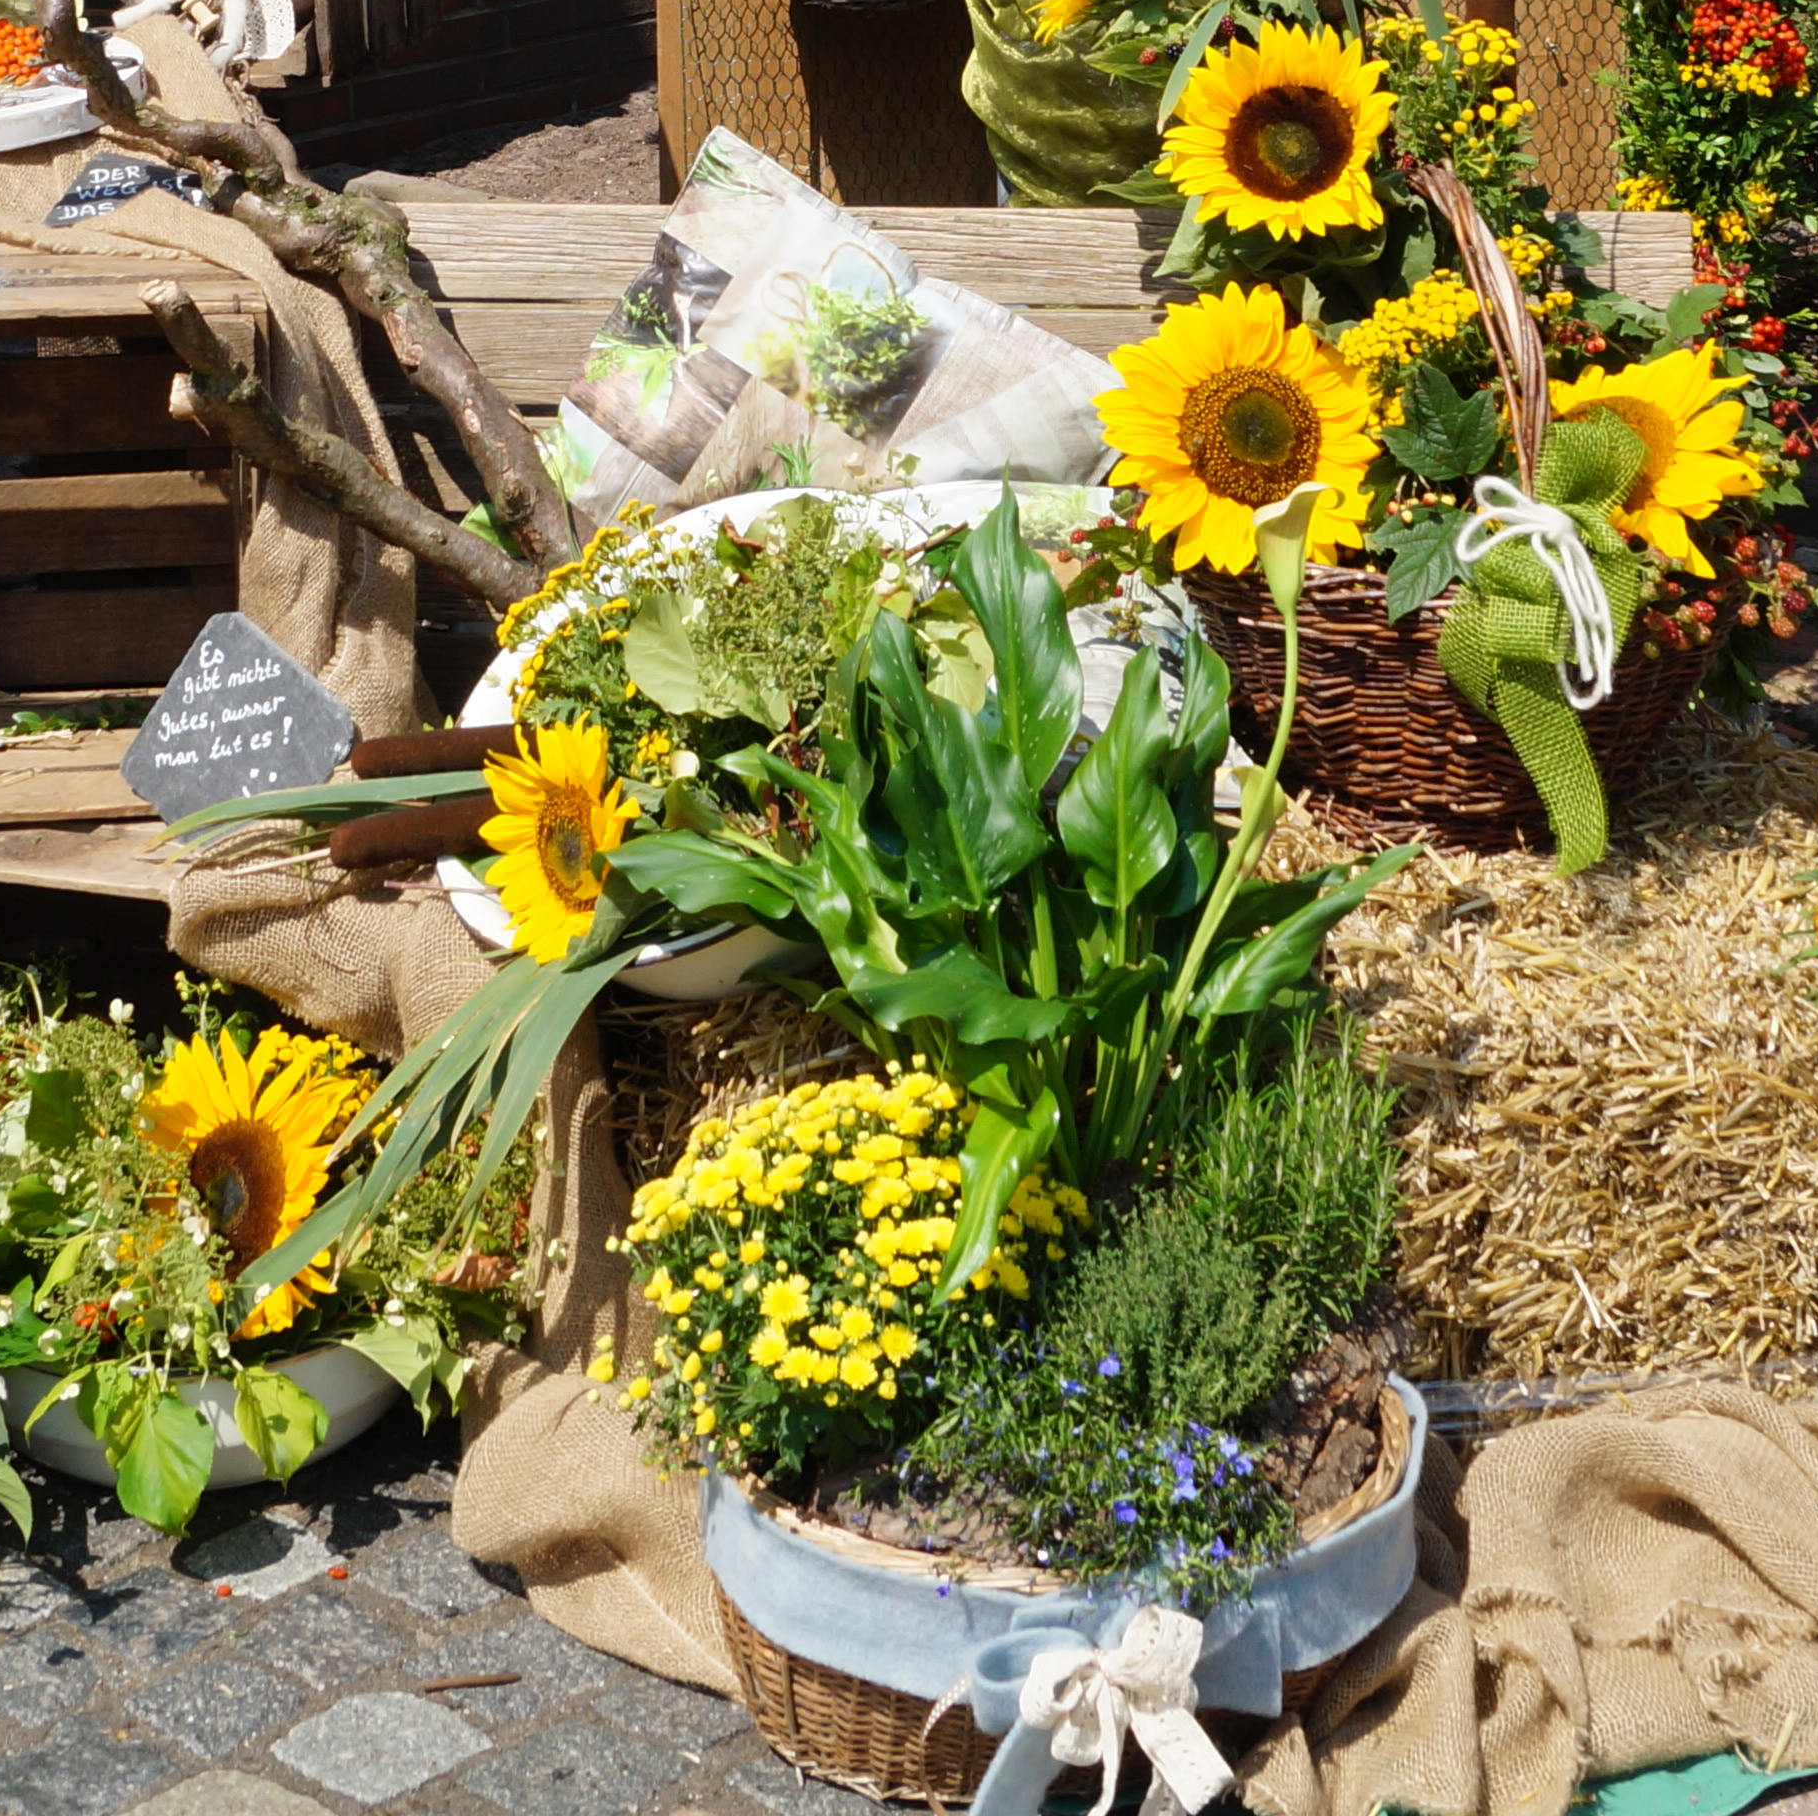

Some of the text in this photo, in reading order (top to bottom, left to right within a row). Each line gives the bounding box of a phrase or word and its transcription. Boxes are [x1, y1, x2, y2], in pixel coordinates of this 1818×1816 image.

[88, 165, 141, 184] DER
[75, 181, 139, 200] WEG
[56, 202, 115, 220] DAS
[199, 639, 225, 669] Es
[182, 667, 222, 704] gibt
[221, 696, 286, 724] ausser
[155, 748, 199, 768] man
[209, 736, 243, 760] tut
[250, 730, 273, 751] es
